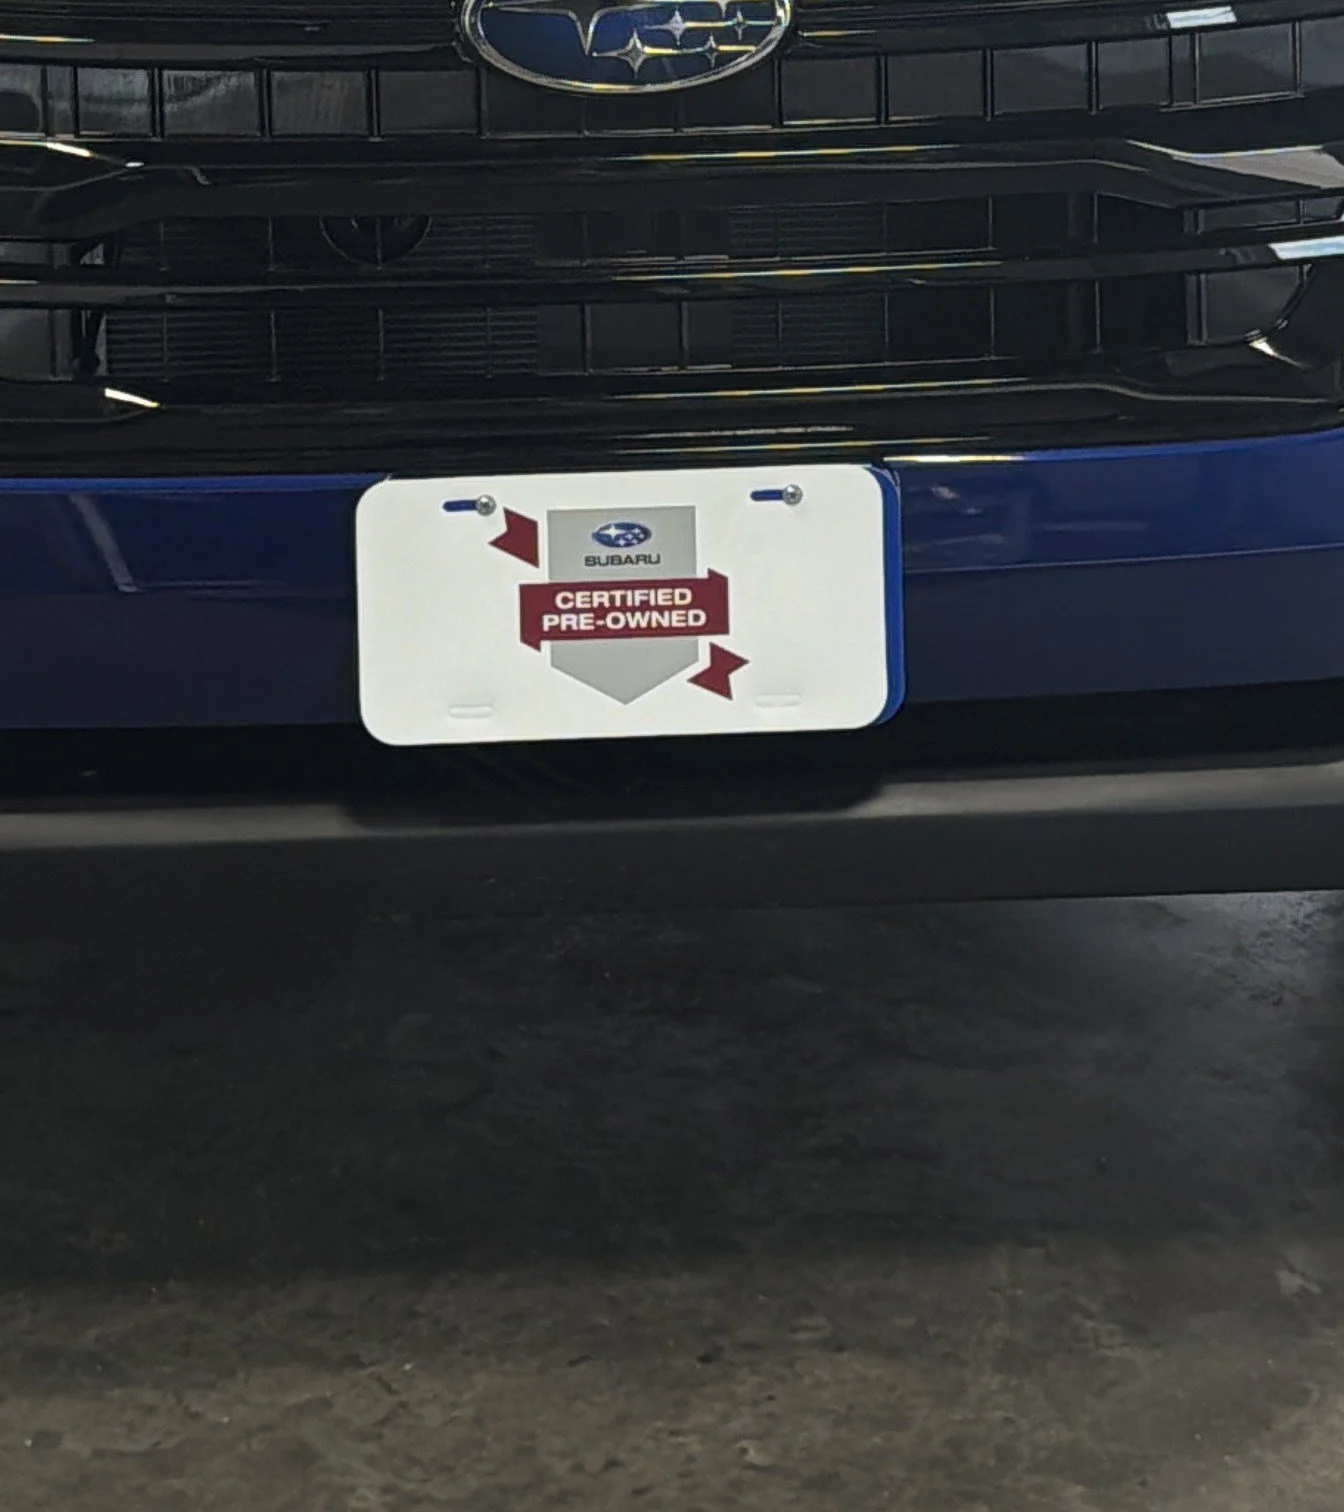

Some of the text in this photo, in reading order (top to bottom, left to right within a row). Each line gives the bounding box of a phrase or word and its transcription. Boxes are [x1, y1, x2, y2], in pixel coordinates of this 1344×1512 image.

[585, 554, 661, 567] SUBARU
[555, 588, 693, 610] CERTIFIED
[542, 609, 707, 632] PRE-OWNED
